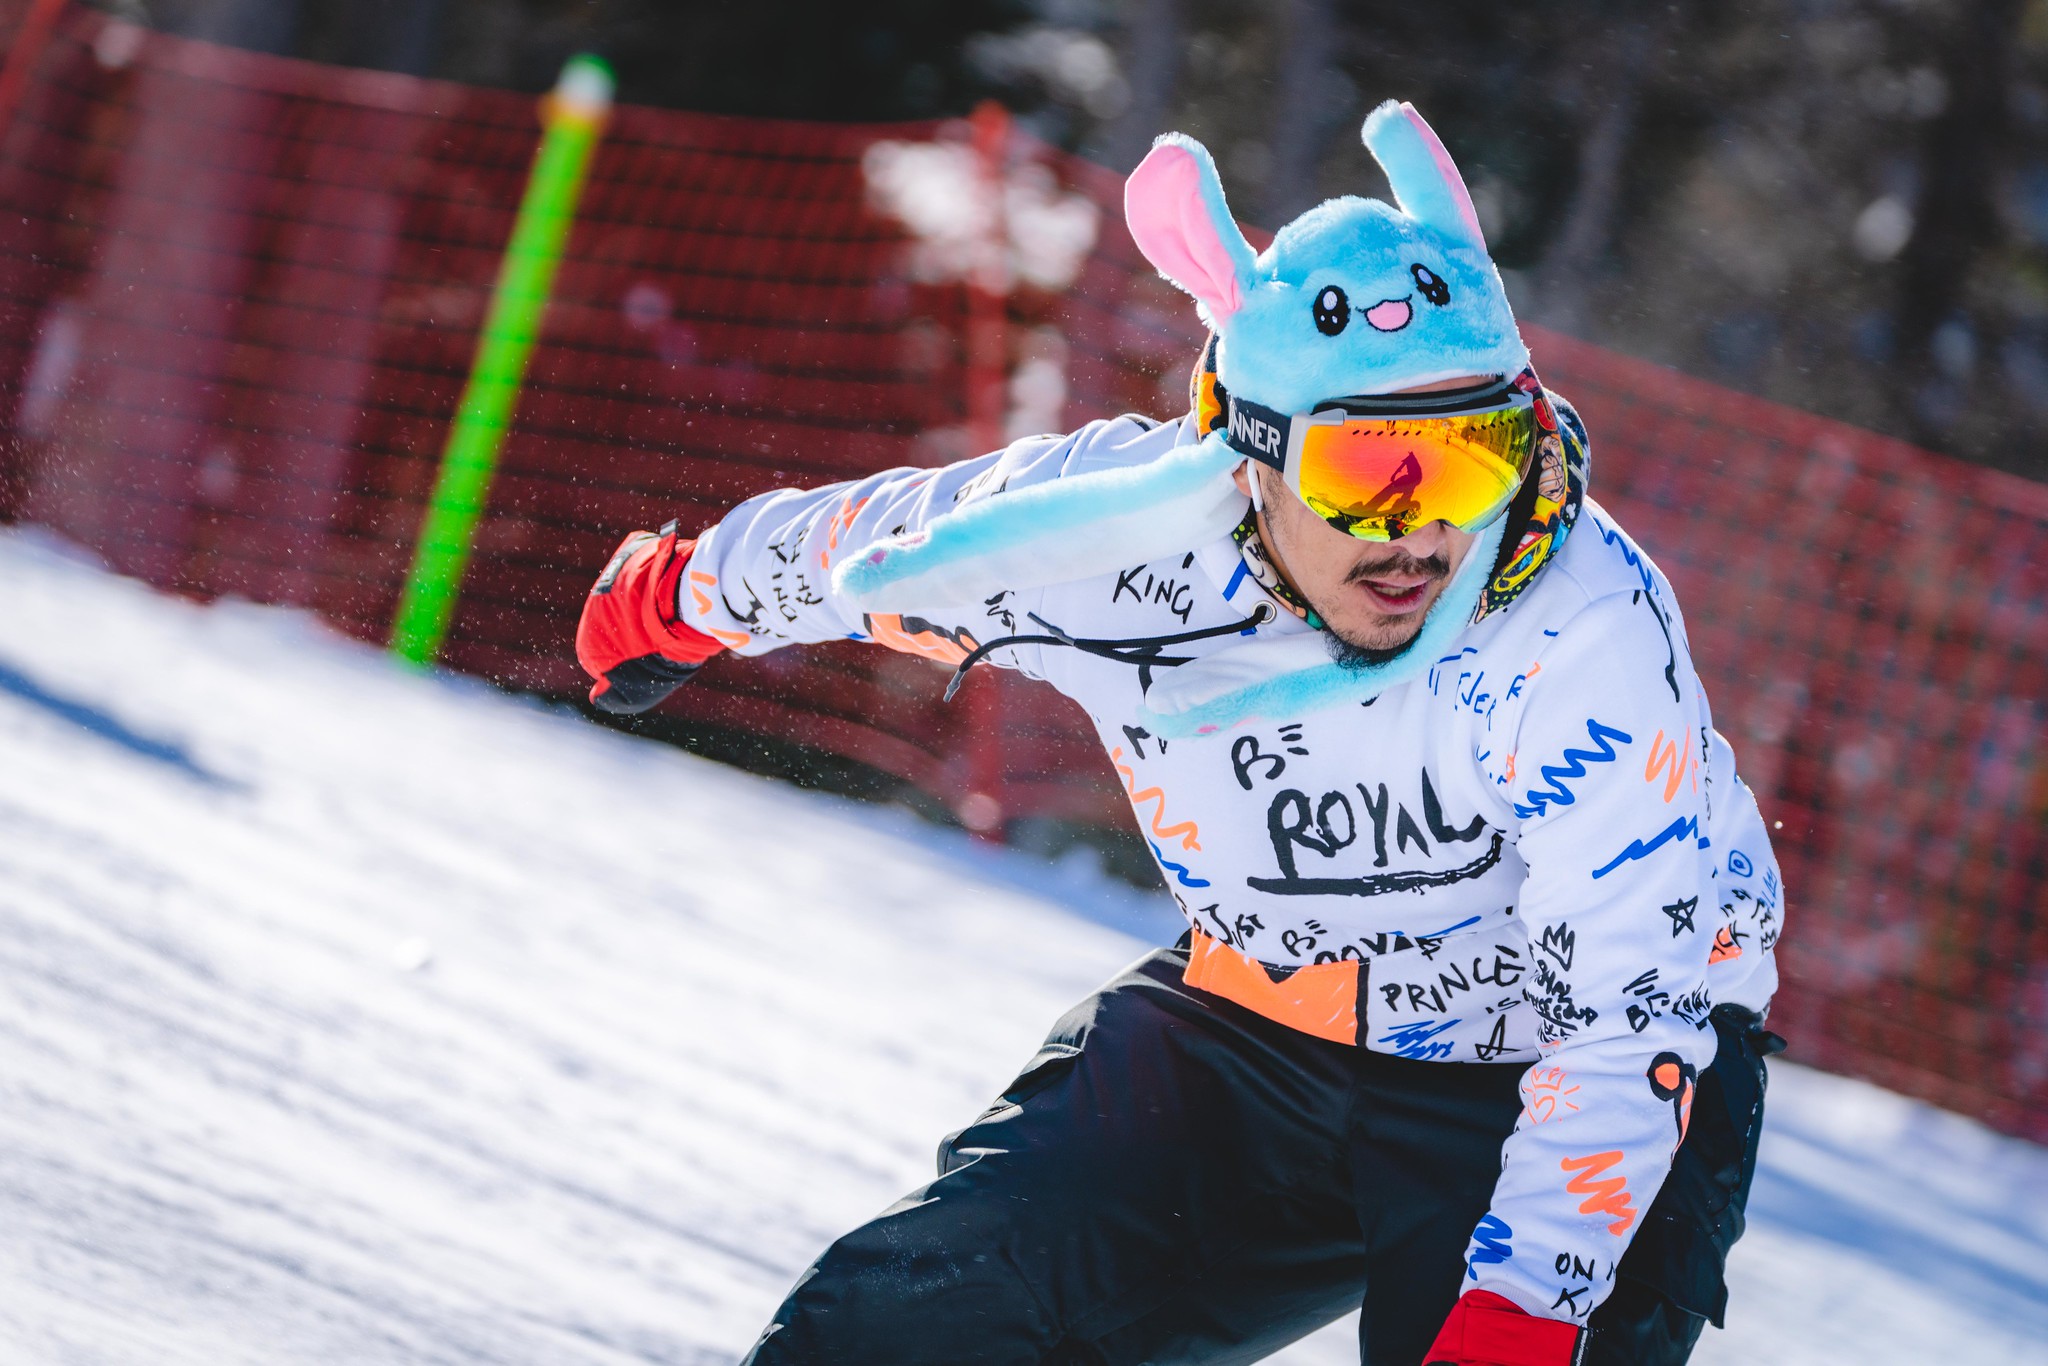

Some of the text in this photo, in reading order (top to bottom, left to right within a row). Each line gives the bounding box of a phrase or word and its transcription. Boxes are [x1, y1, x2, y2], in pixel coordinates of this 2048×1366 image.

[1112, 563, 1194, 625] KING
[1267, 766, 1488, 879] ROYAL
[1379, 944, 1526, 1014] PRINCE
[1555, 1252, 1595, 1282] ON
